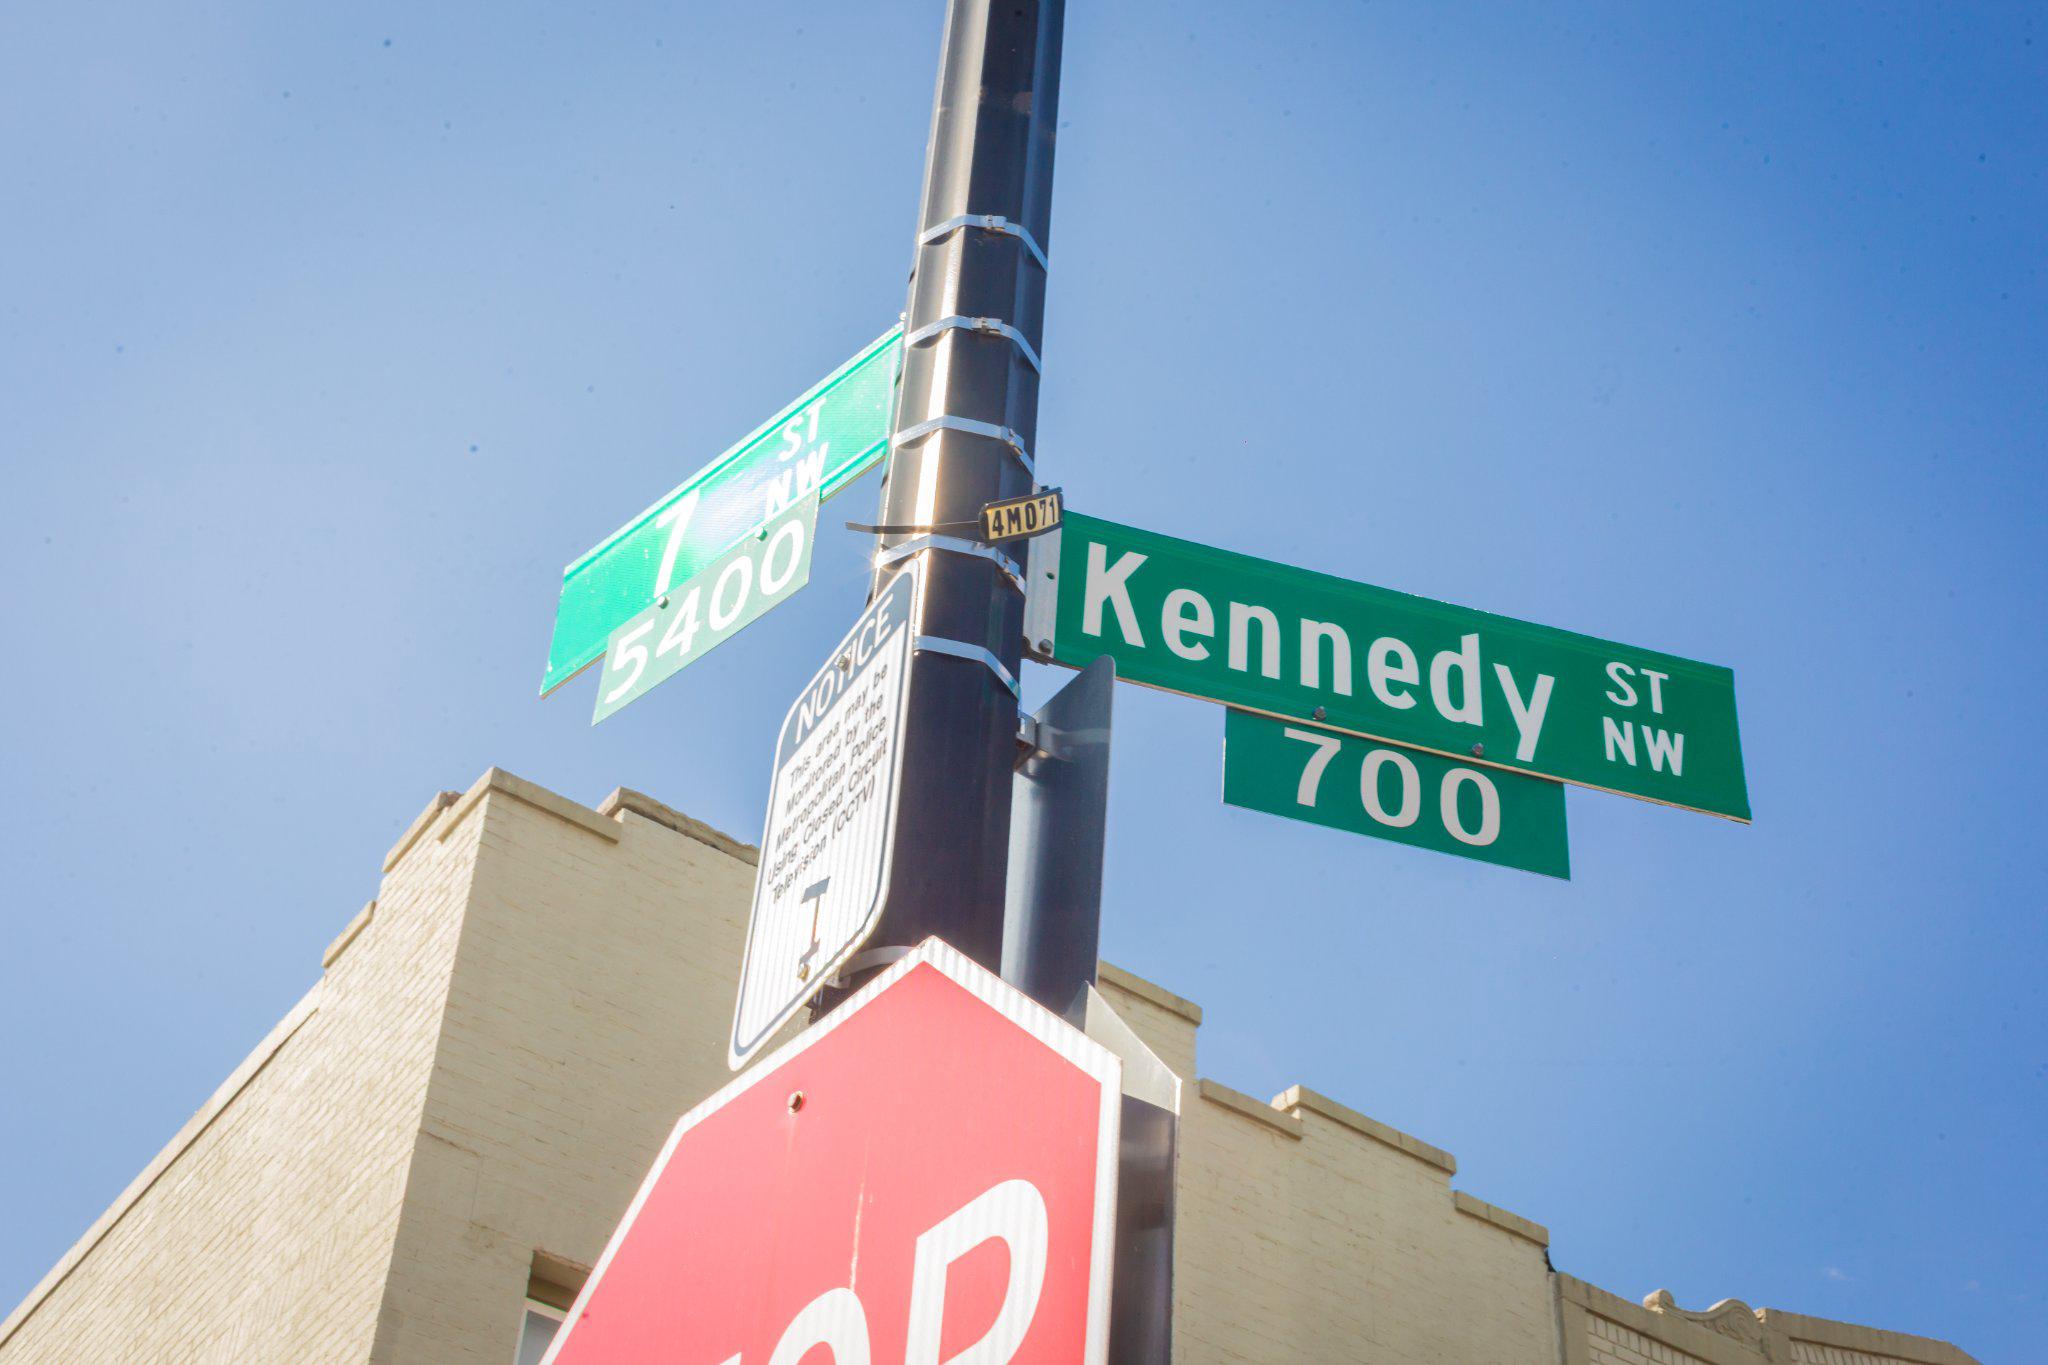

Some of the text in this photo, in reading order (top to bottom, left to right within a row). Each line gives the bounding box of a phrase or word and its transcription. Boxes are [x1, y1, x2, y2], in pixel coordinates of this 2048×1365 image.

[764, 442, 829, 523] NW
[779, 397, 826, 462] ST
[653, 487, 701, 599] 7
[604, 519, 805, 704] 5400
[795, 593, 894, 744] NOTICE
[1082, 541, 1555, 763] Kennedy
[790, 664, 888, 788] This area may be
[1602, 717, 1685, 777] NW
[1605, 661, 1669, 714] ST
[767, 735, 888, 885] Using Closed Circuit
[776, 716, 886, 852] Metropolitan Police
[785, 694, 884, 818] Monitored by the
[1283, 726, 1501, 847] 700
[773, 774, 875, 904] Television (CCTV)
